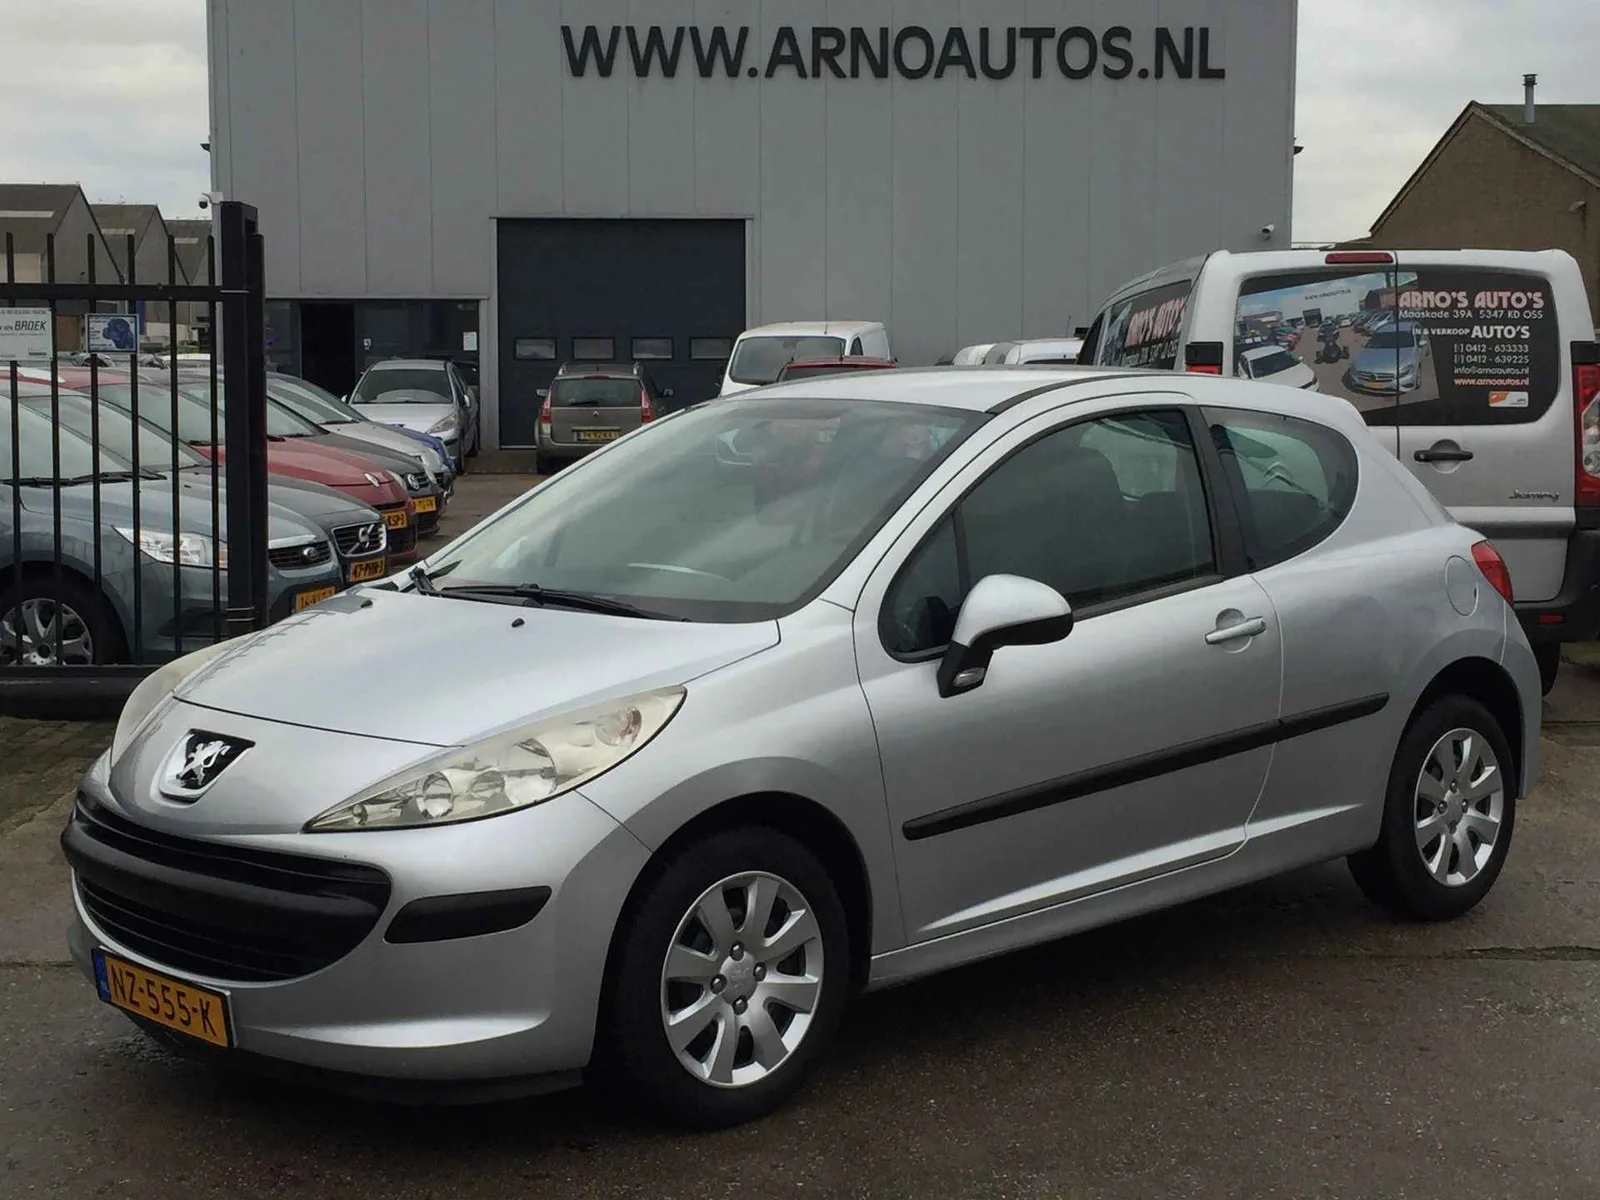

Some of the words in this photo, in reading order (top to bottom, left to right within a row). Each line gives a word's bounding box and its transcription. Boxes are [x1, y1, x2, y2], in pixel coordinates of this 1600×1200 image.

[561, 25, 1226, 80] WWW.ARNOAUTOS.NL
[1399, 291, 1469, 309] ARNO'S
[1474, 291, 1545, 309] AUTO'S
[1399, 309, 1450, 319] Maaskade
[1453, 310, 1473, 318] 39A
[1479, 310, 1504, 318] 5347
[1507, 310, 1520, 318] KD
[1523, 310, 1543, 319] OSS
[14, 320, 47, 331] BROEK
[1471, 325, 1531, 339] AUTO'S
[1494, 344, 1529, 353] 633333
[1494, 355, 1530, 364] 639225
[1454, 377, 1530, 386] www.arnoautos.nl
[111, 965, 218, 1038] NZ-555-K
